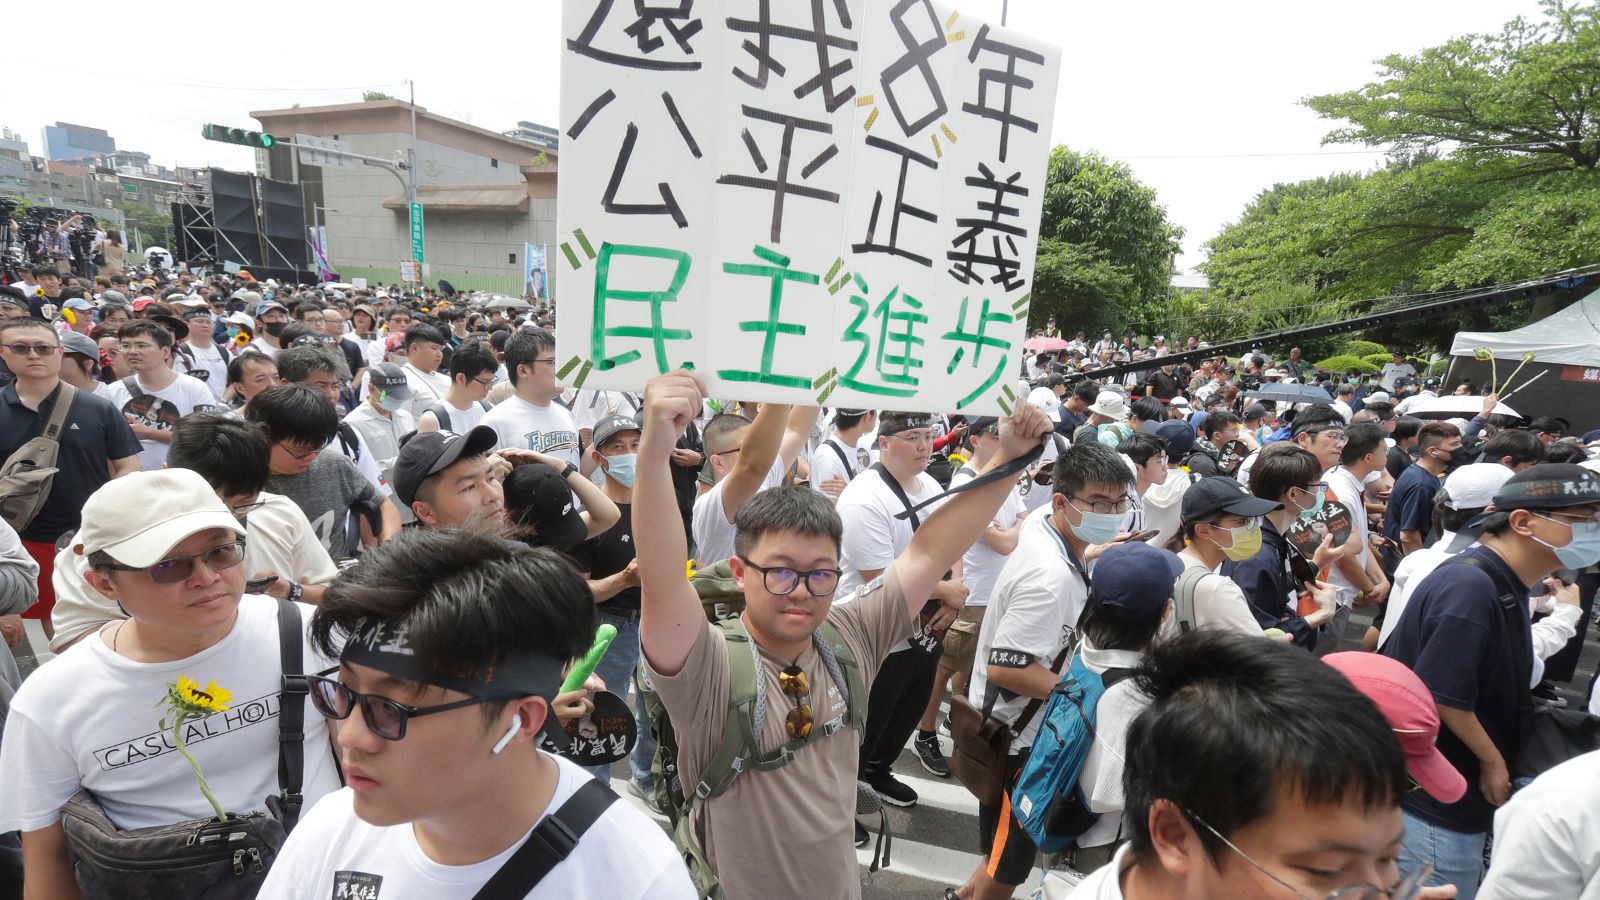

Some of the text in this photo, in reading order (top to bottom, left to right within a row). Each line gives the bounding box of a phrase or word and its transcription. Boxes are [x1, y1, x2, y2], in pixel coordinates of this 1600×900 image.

[567, 89, 1029, 292] 公平正義
[590, 241, 1014, 410] 民主進步
[990, 650, 1028, 665] 民眾作主
[104, 719, 218, 767] CASUAL
[337, 881, 376, 900] 民眾作主
